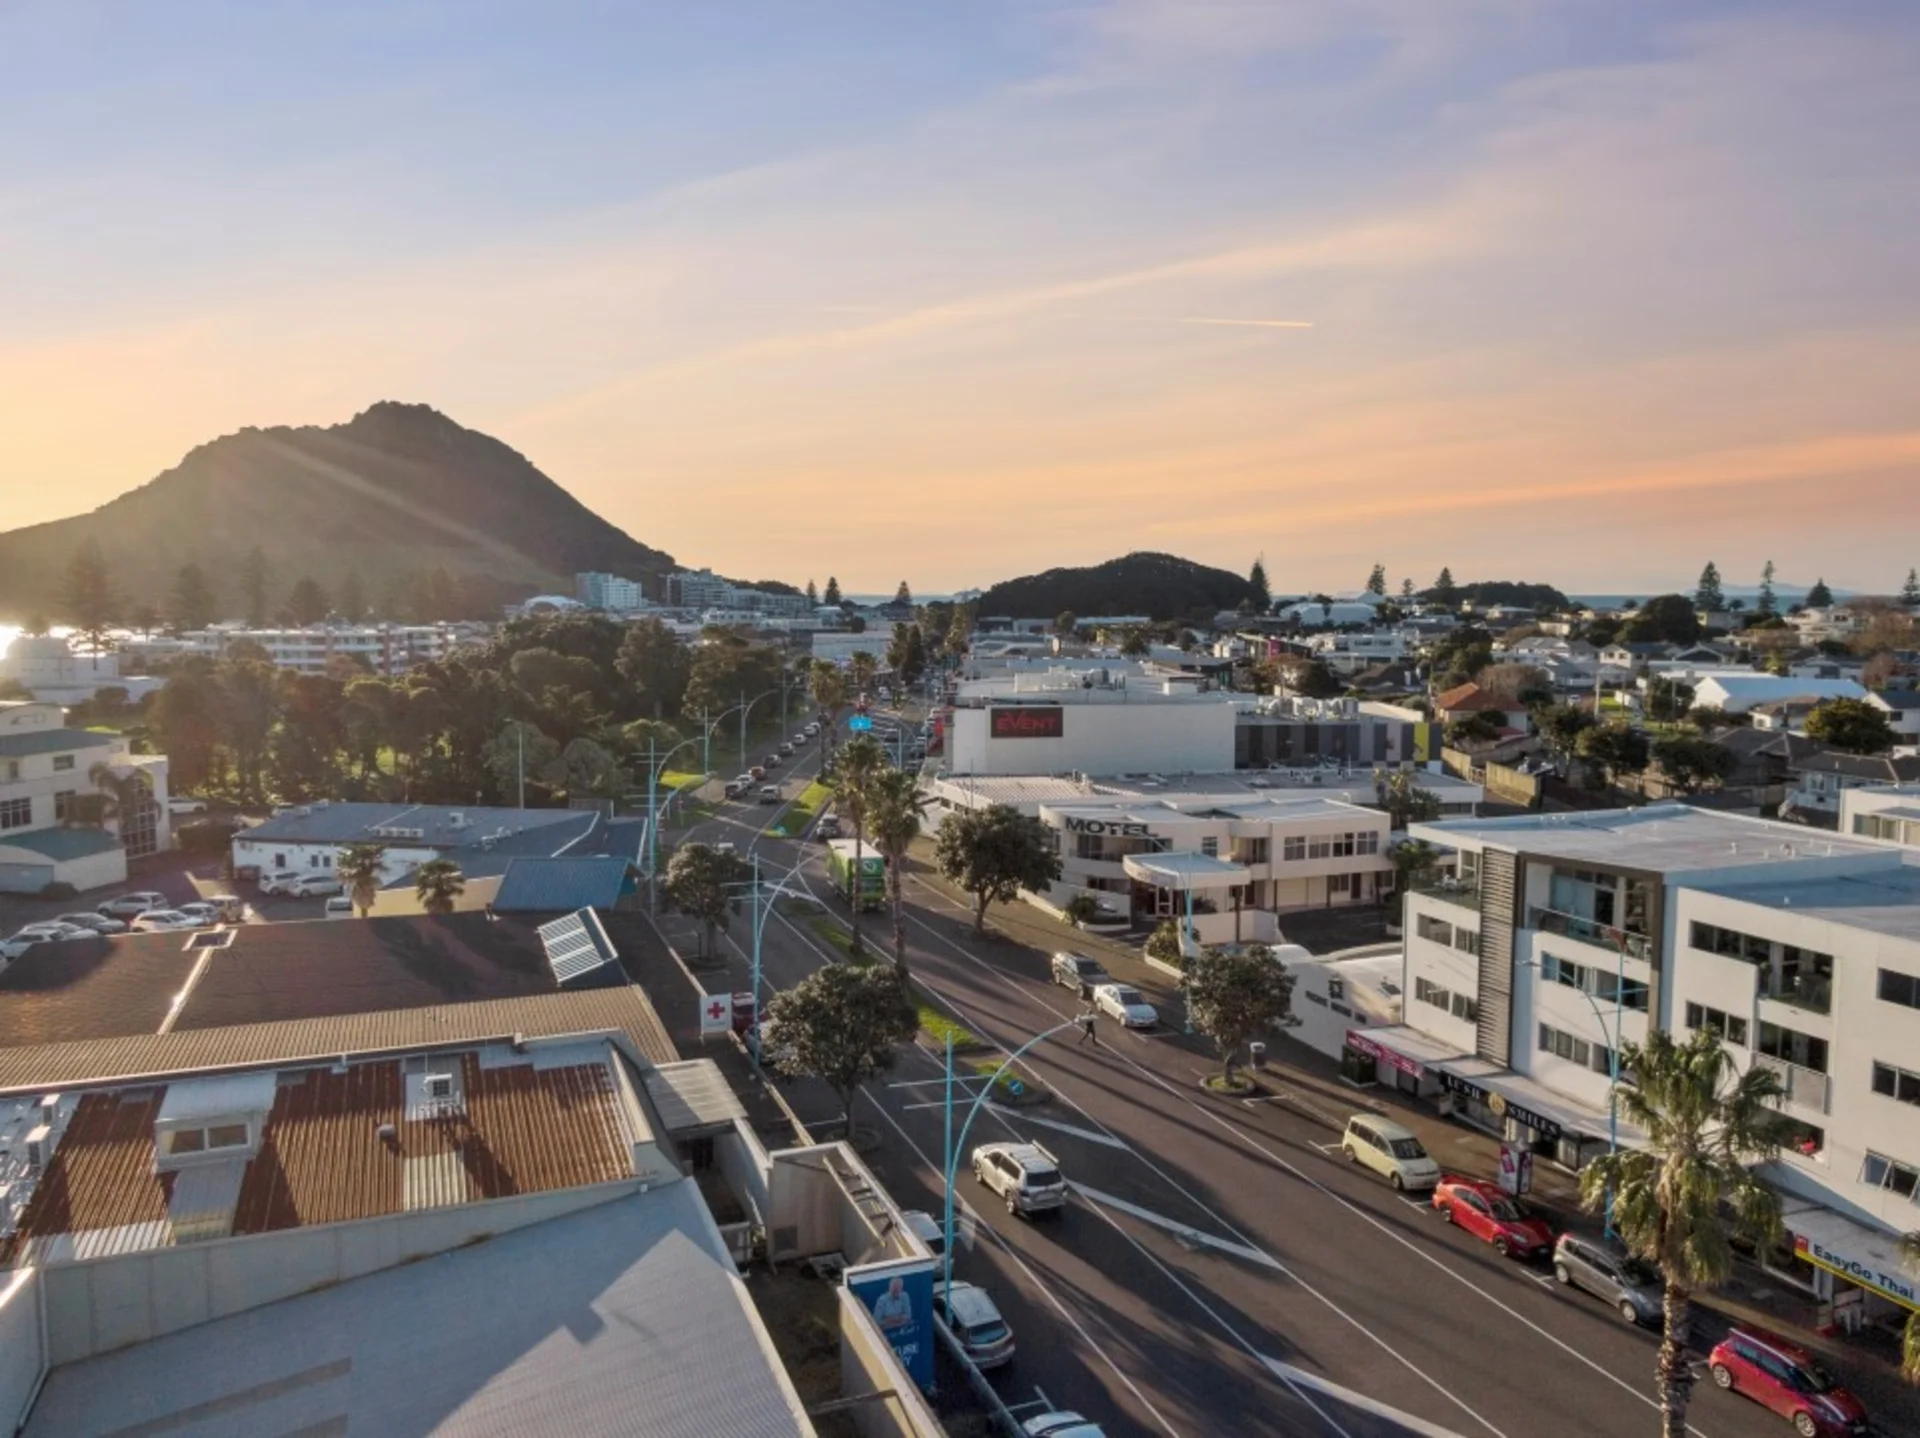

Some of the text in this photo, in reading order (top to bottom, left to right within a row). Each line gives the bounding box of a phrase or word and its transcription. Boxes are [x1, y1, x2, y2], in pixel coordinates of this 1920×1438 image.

[995, 711, 1057, 732] EVENT
[1065, 815, 1159, 837] MOTEL
[1813, 1244, 1914, 1300] EasyGo Thai
